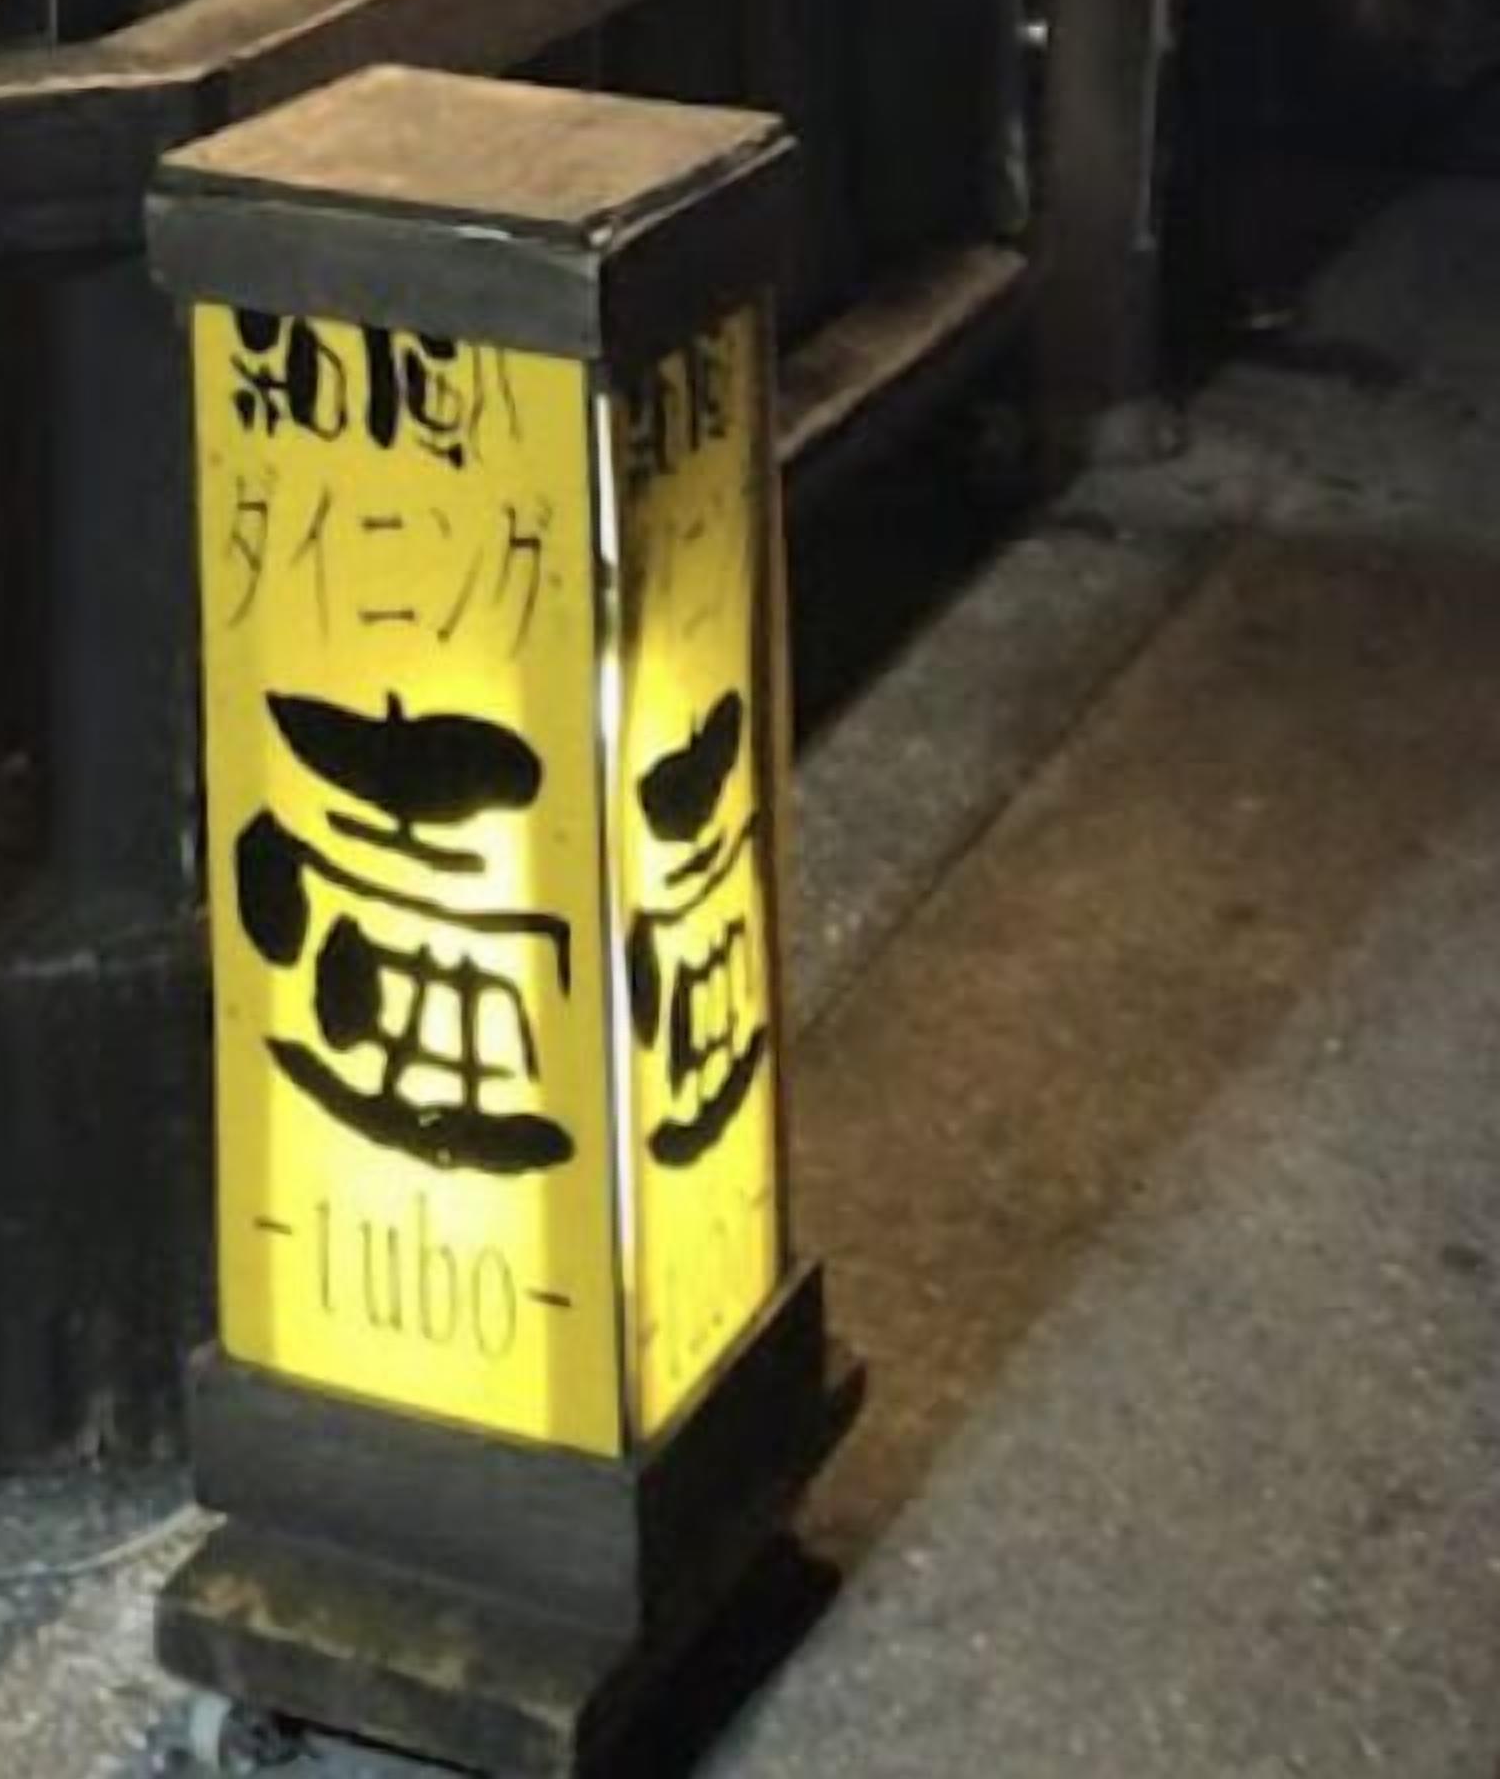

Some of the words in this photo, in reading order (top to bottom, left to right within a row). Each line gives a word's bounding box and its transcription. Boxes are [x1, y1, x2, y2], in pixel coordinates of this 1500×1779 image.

[223, 458, 555, 659] ダイニング
